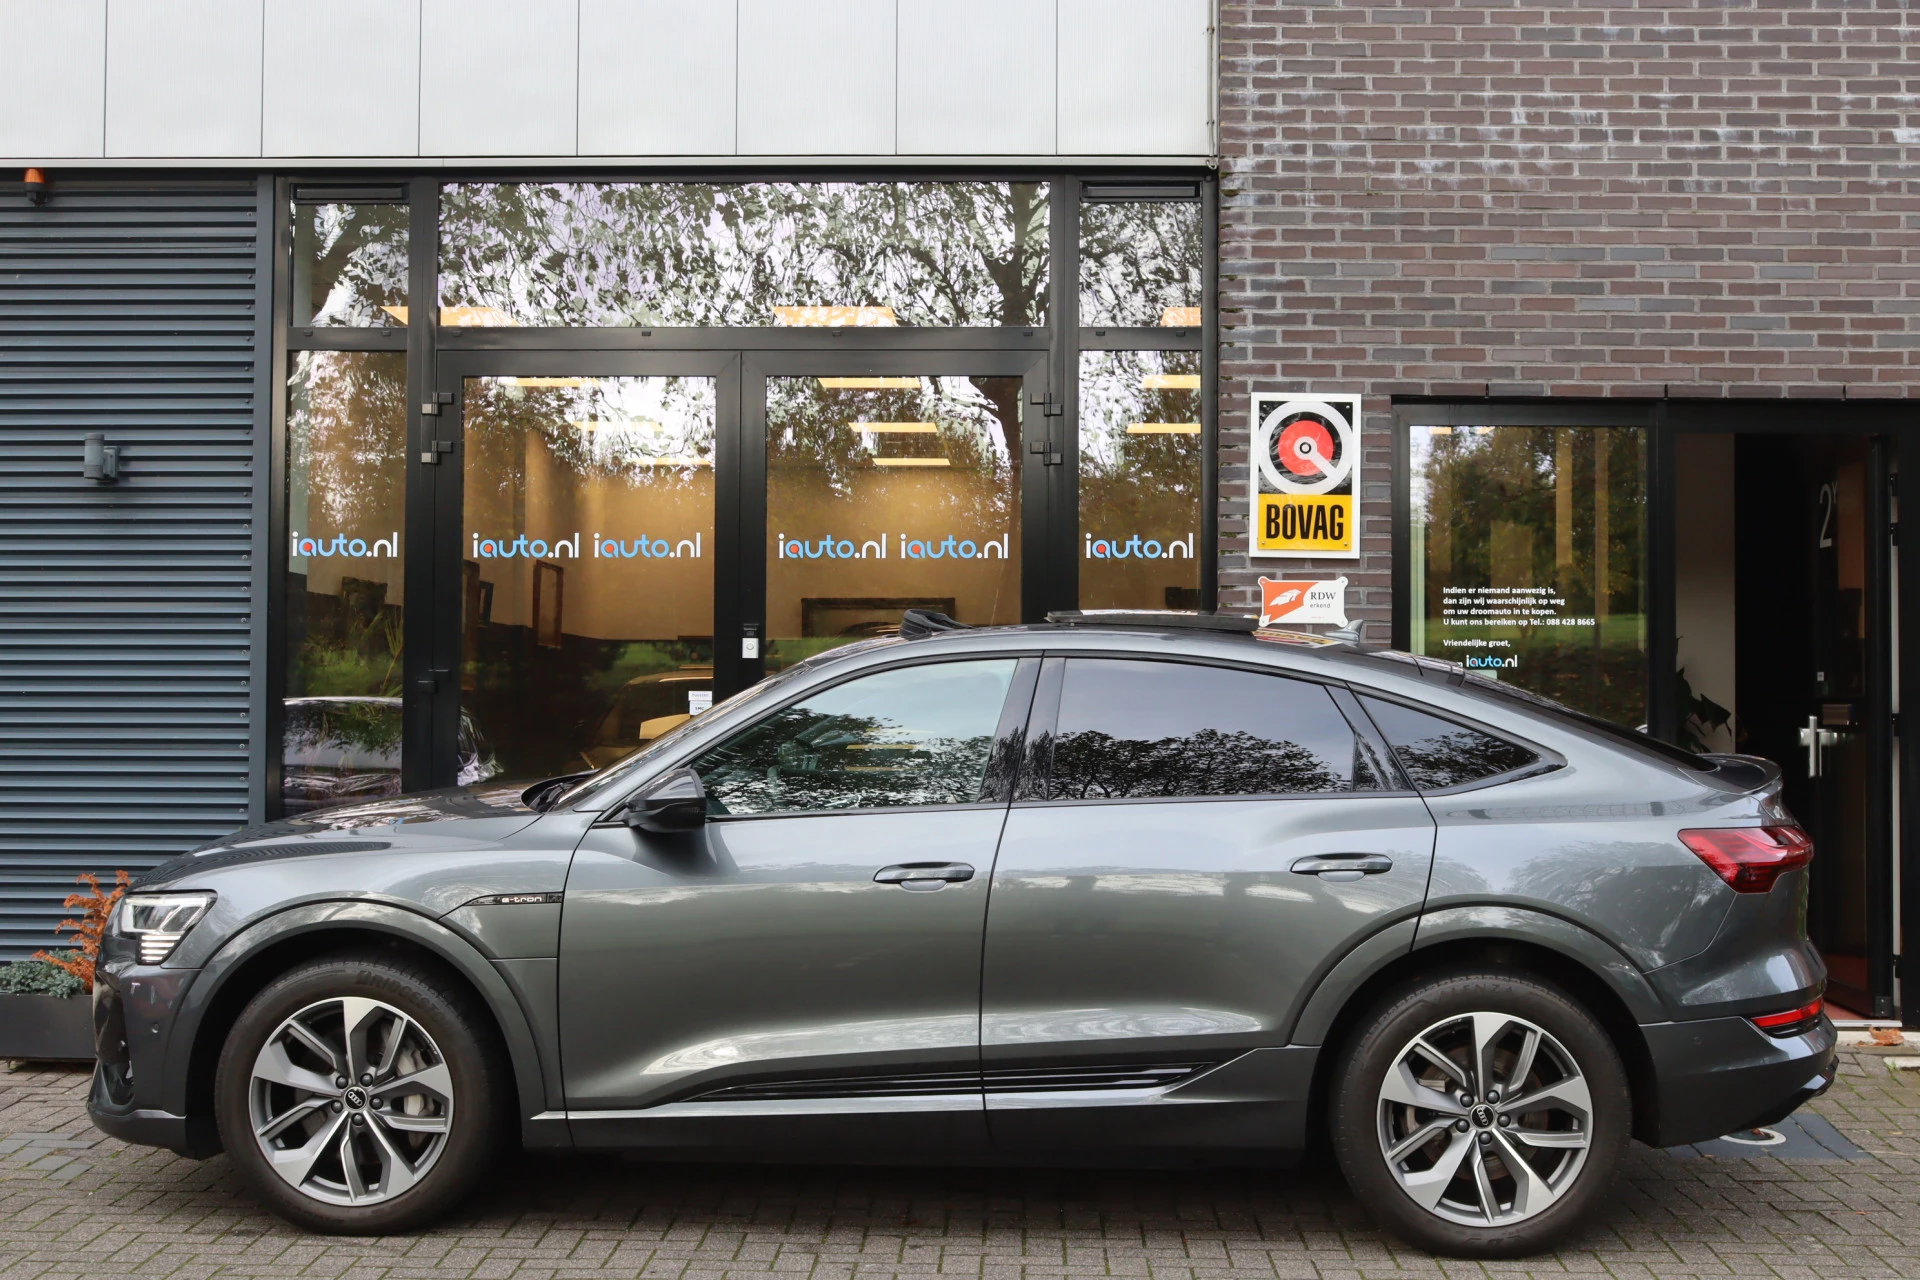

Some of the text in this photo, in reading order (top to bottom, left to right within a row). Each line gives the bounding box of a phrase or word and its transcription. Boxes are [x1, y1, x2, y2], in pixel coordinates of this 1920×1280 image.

[1266, 503, 1344, 541] BOVAG
[291, 531, 398, 558] iauto.nl
[472, 532, 580, 559] iauto.nl
[593, 532, 701, 559] iauto.nl
[778, 533, 886, 559] iauto.nl
[900, 533, 1009, 559] iauto.nl
[1085, 533, 1194, 559] iauto.nl
[1310, 591, 1337, 600] RDW
[1459, 597, 1472, 605] zijn
[1473, 597, 1485, 605] wij
[1486, 597, 1537, 605] waarschijnlijk
[1512, 587, 1546, 595] aanwezig
[1547, 587, 1556, 595] is,
[1531, 608, 1557, 616] kopen.
[1443, 639, 1511, 648] Vriendelijke groet,
[1465, 654, 1518, 668] iauto.nl
